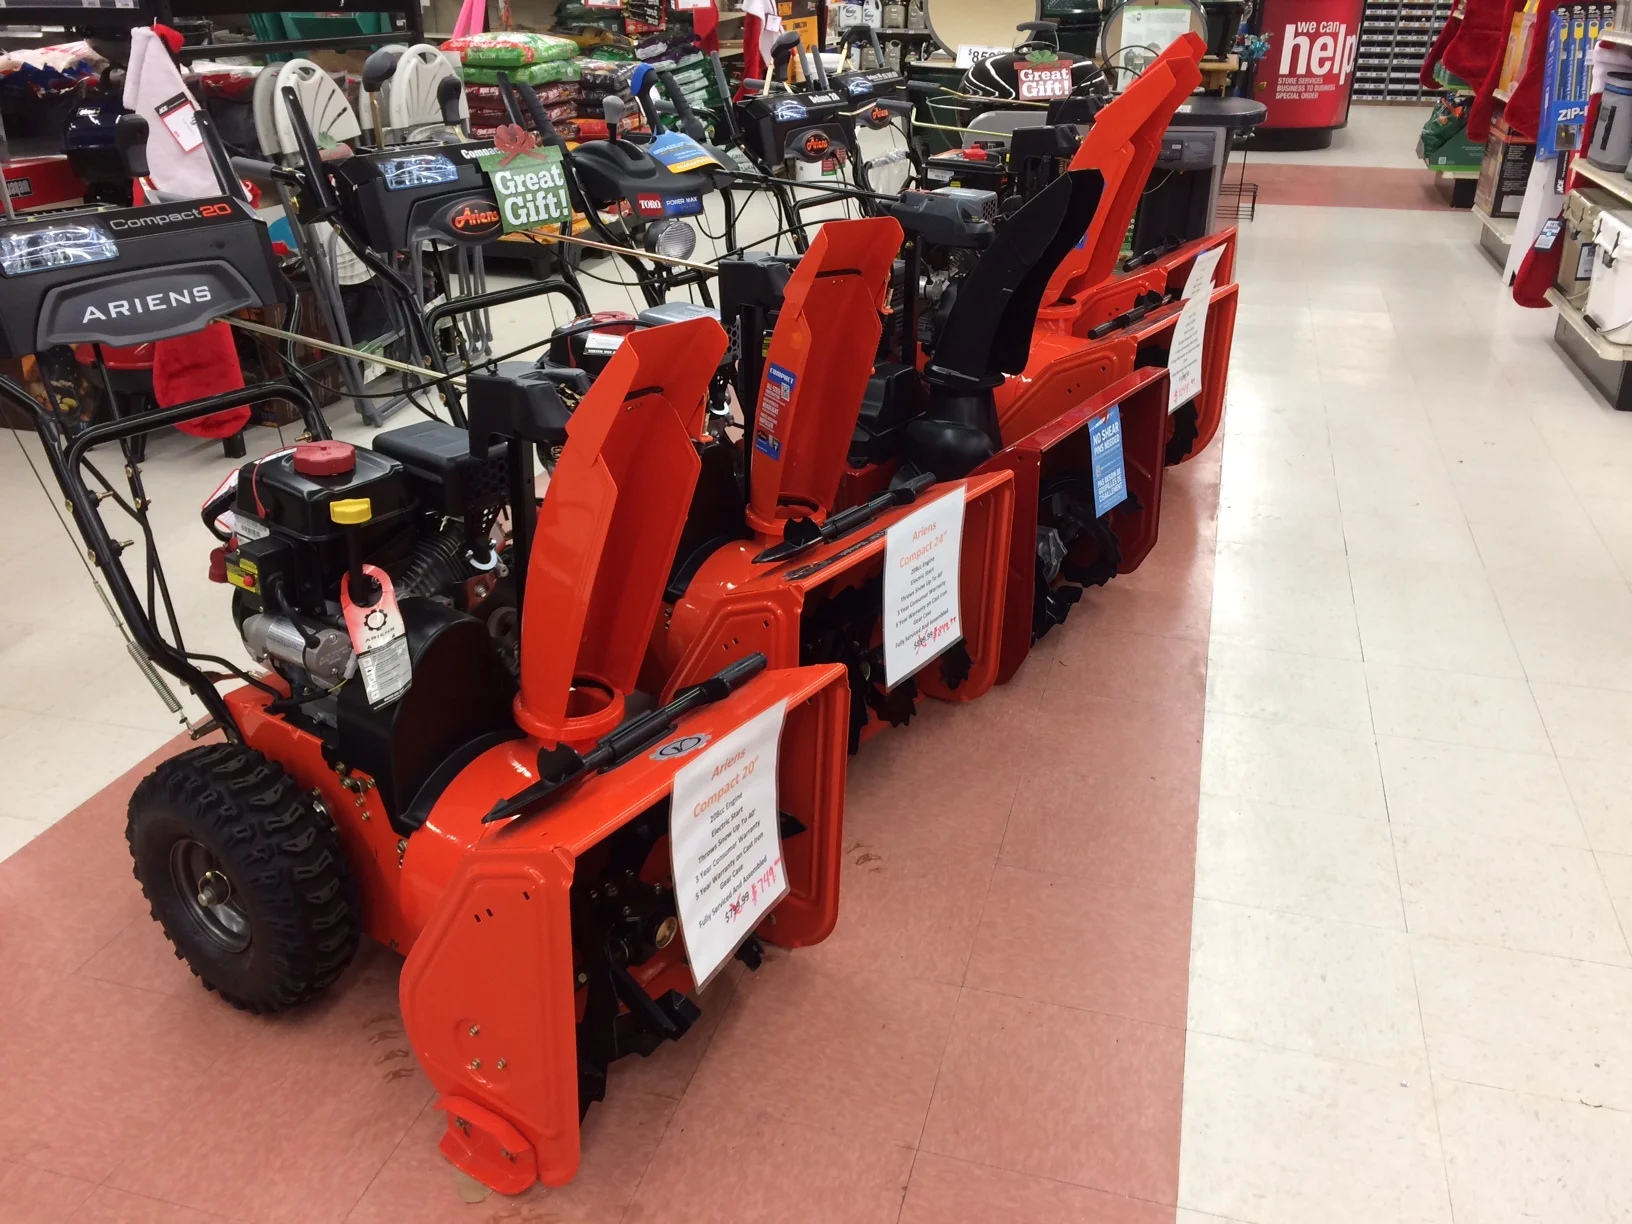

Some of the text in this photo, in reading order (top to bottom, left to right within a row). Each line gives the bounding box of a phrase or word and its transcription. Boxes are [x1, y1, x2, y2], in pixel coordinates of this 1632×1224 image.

[1297, 21, 1340, 33] we can
[1020, 68, 1070, 81] Great
[1022, 79, 1070, 97] Gift!
[460, 147, 505, 160] Compac
[806, 136, 829, 151] Ariens
[494, 165, 564, 195] Great
[504, 188, 569, 226] Gift!
[639, 199, 662, 209] TORO
[666, 197, 685, 206] POWER
[454, 207, 500, 228] Ariens
[82, 285, 212, 324] ARIENS
[769, 367, 794, 385] COMPACT
[1092, 421, 1120, 445] NO SHEAR
[1093, 433, 1120, 456] PINS NEEDED
[912, 521, 937, 542] Ariens
[899, 530, 949, 569] Compact 24"
[922, 556, 935, 569] Engine
[900, 591, 915, 602] Throws
[914, 583, 926, 593] Snow
[925, 578, 932, 586] Up
[931, 573, 938, 582] To
[910, 566, 935, 586] Electric Start
[899, 617, 908, 626] Year
[908, 604, 927, 620] Warranty
[926, 600, 932, 608] on
[931, 595, 940, 604] Cast
[939, 589, 948, 599] Iron
[900, 604, 910, 614] Year
[909, 592, 929, 608] Consumer
[928, 580, 947, 595] Warranty
[894, 607, 949, 648] Fully Serviced And Assembled
[912, 610, 932, 626] Gear Case
[365, 626, 396, 643] ARIENS
[711, 747, 746, 781] Ariens
[693, 755, 760, 819] Compact 20"
[725, 792, 743, 811] Engine
[711, 806, 744, 838] Electric Start
[694, 818, 761, 883] 3 Year Consumer Warranty
[698, 841, 718, 864] Throws
[717, 830, 733, 848] Snow
[732, 822, 741, 834] Up
[740, 816, 748, 827] To
[695, 832, 765, 901] 5 Year Warranty on Cast Iron
[719, 863, 744, 890] Gear Case
[698, 854, 768, 929] Fully Serviced And Assembled
